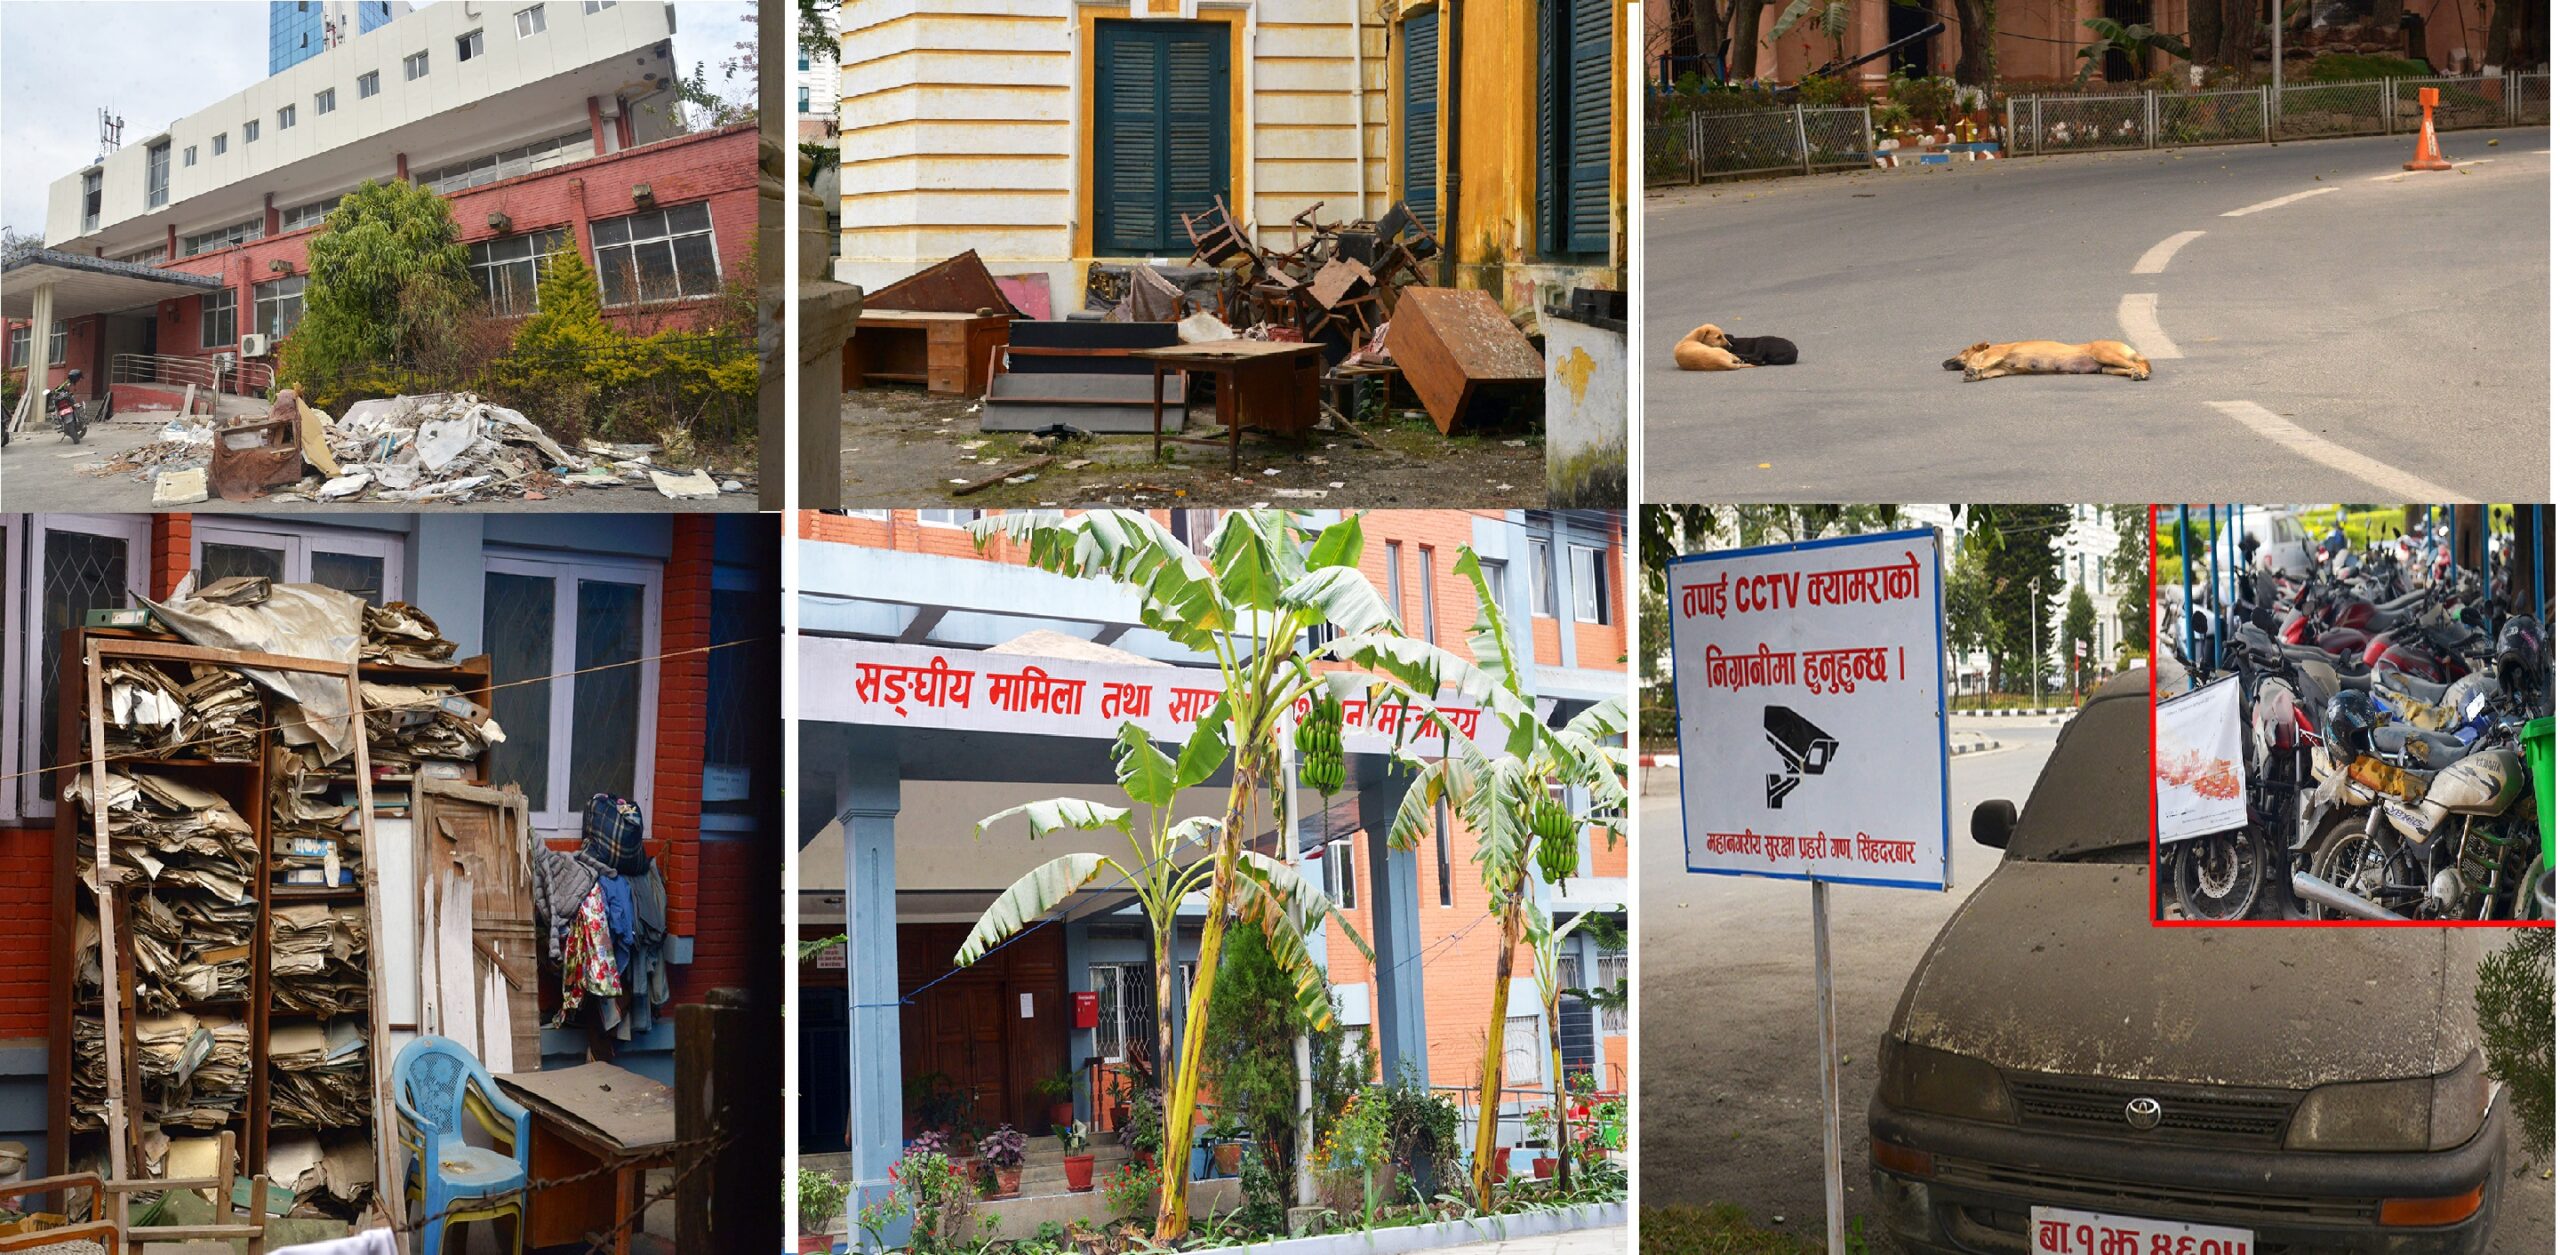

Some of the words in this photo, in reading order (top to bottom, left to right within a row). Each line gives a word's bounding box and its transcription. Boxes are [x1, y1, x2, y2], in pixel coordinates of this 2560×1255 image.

[1682, 572, 1728, 619] तपाई
[1735, 571, 1801, 613] CCTV
[1807, 550, 1921, 606] क्यामराको
[855, 655, 976, 718] सङ्घीय
[986, 665, 1087, 715] मामिला
[1101, 682, 1152, 719] तथा
[1706, 642, 1796, 693] निग्रानीमा
[1803, 647, 1889, 695] हुनुहुन्छ
[1707, 829, 1761, 855] महानगरीय
[1764, 835, 1795, 862] सुरक्षा
[1799, 831, 1827, 860] प्रहरी
[1857, 832, 1916, 864] सिंहदरबार
